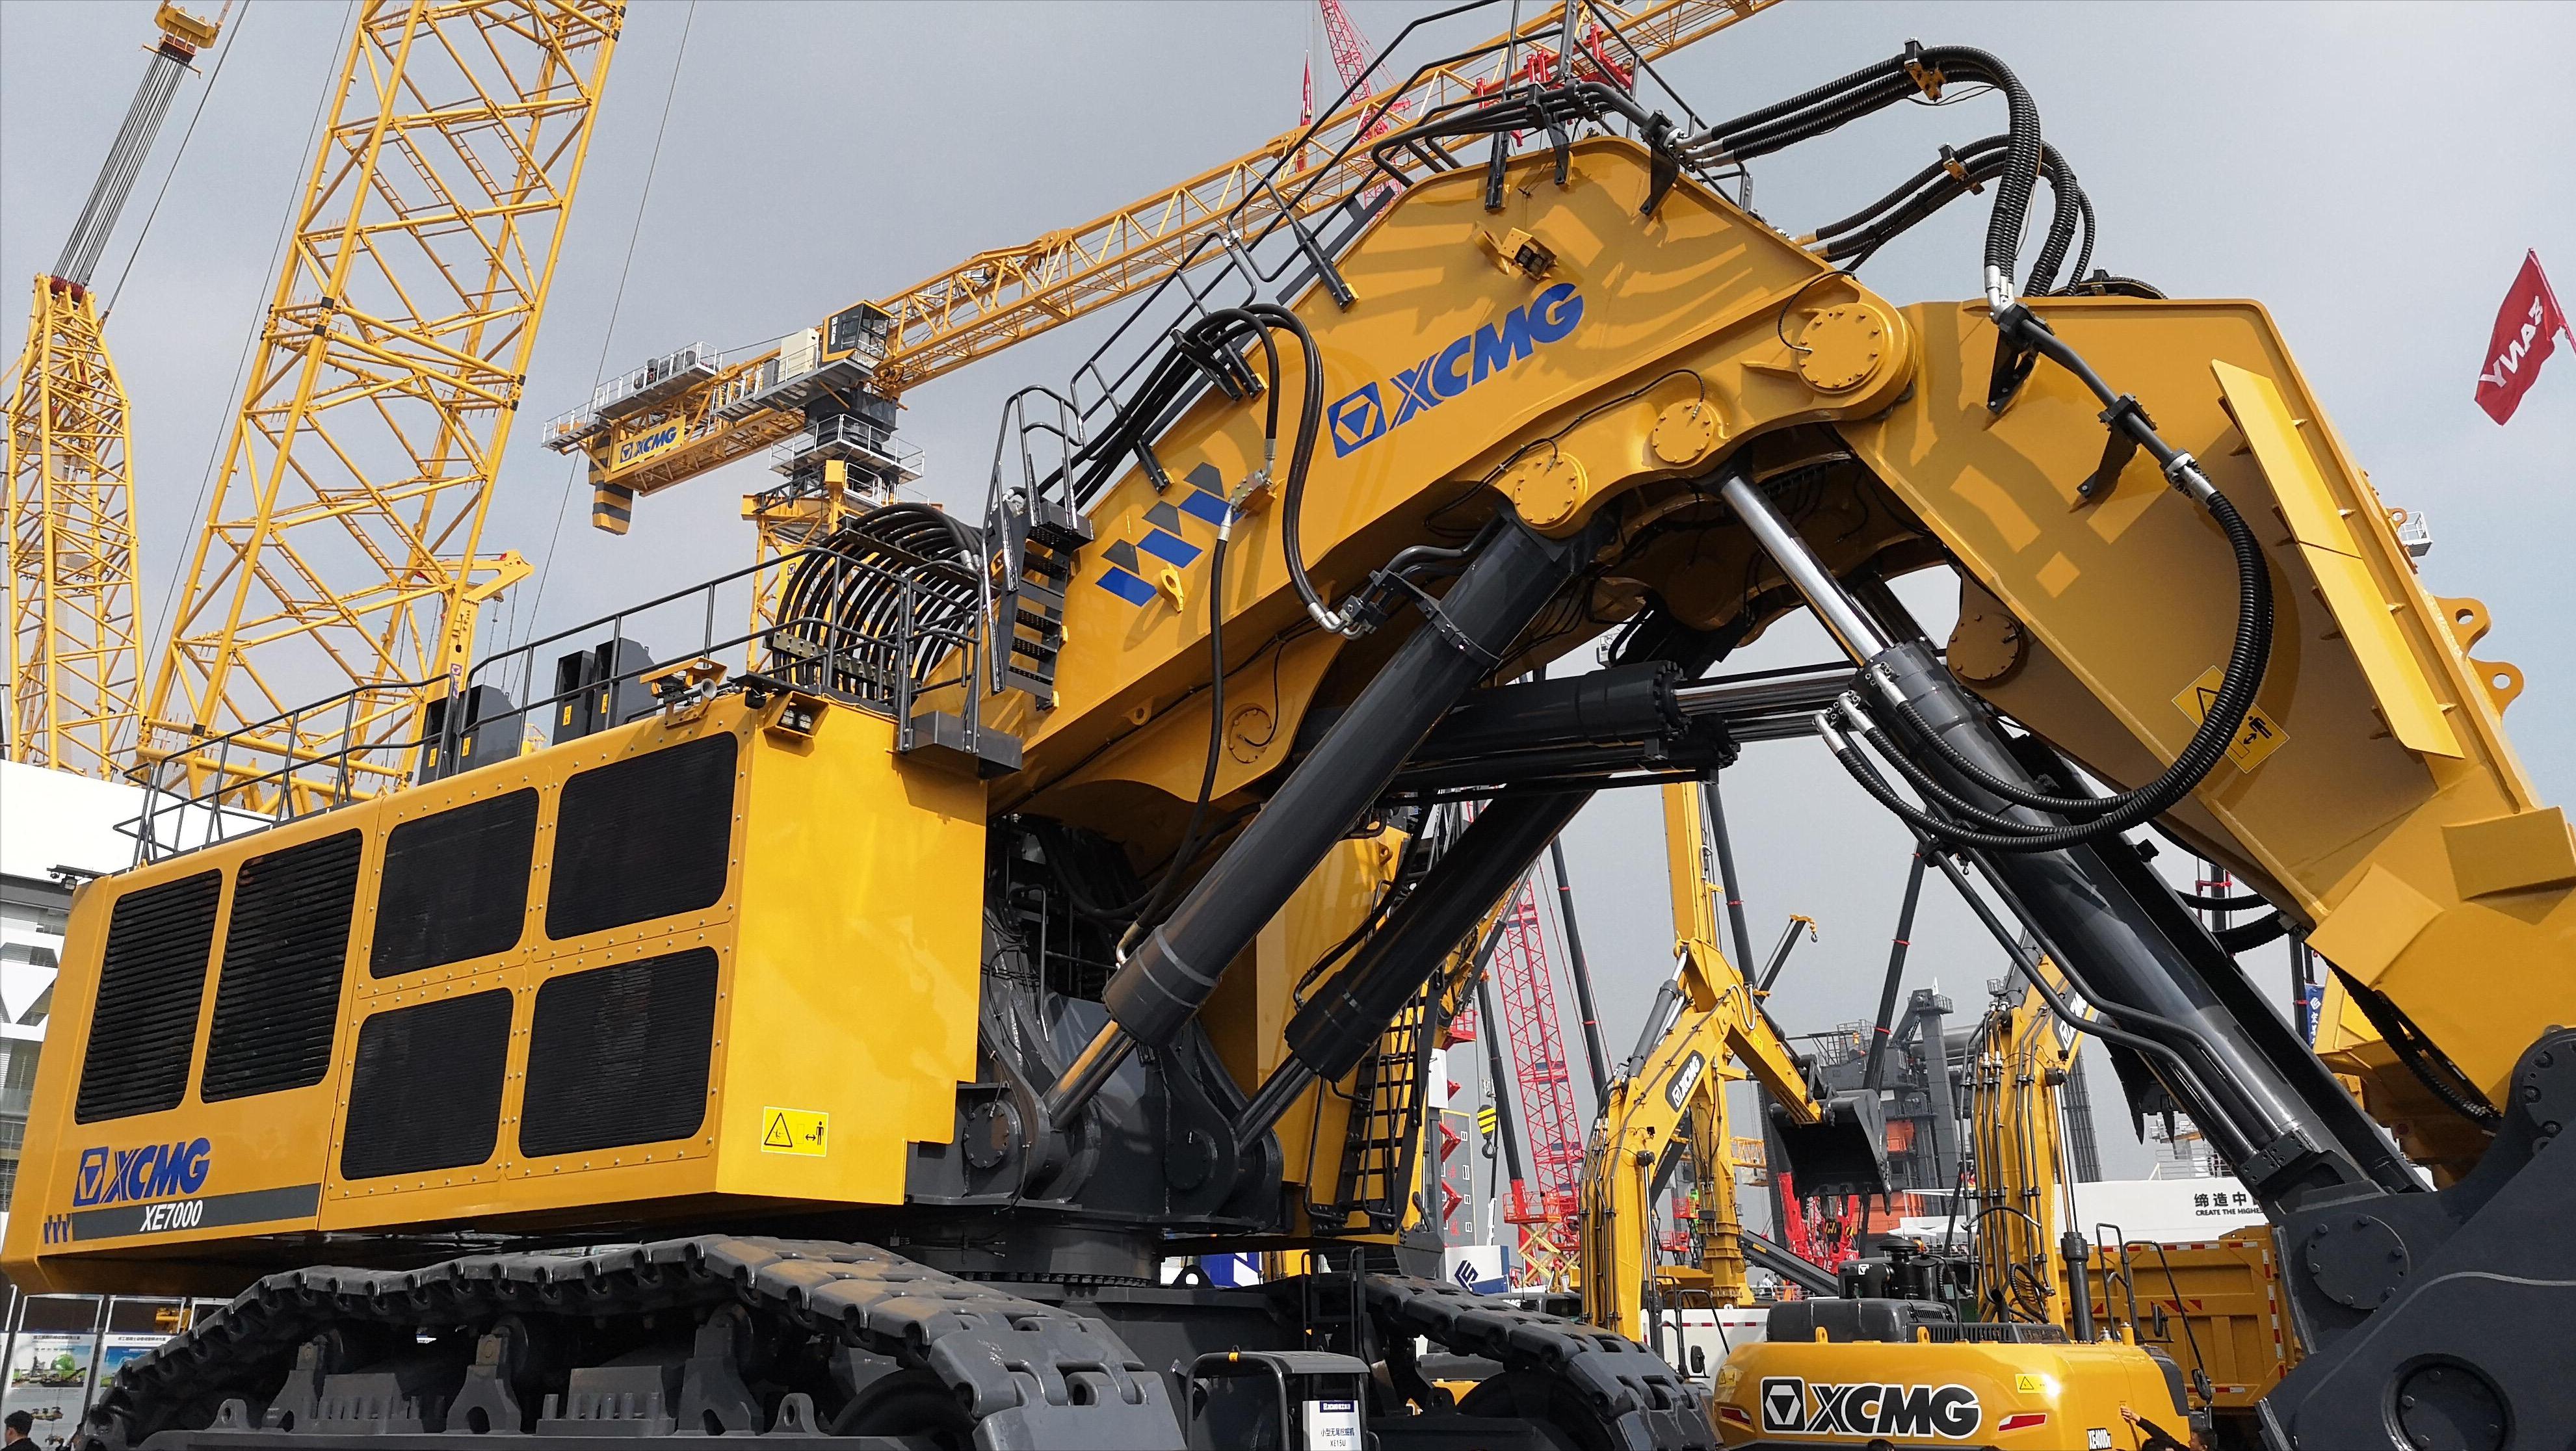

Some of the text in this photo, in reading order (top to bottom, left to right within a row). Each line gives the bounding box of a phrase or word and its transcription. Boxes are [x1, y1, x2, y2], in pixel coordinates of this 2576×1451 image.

[1389, 283, 1584, 431] XCMG
[633, 426, 677, 458] XCMG
[1677, 1056, 1700, 1096] XCMG
[100, 1138, 211, 1203] XCMG
[140, 1200, 204, 1232] XE7000
[1805, 1382, 1982, 1440] XCMG
